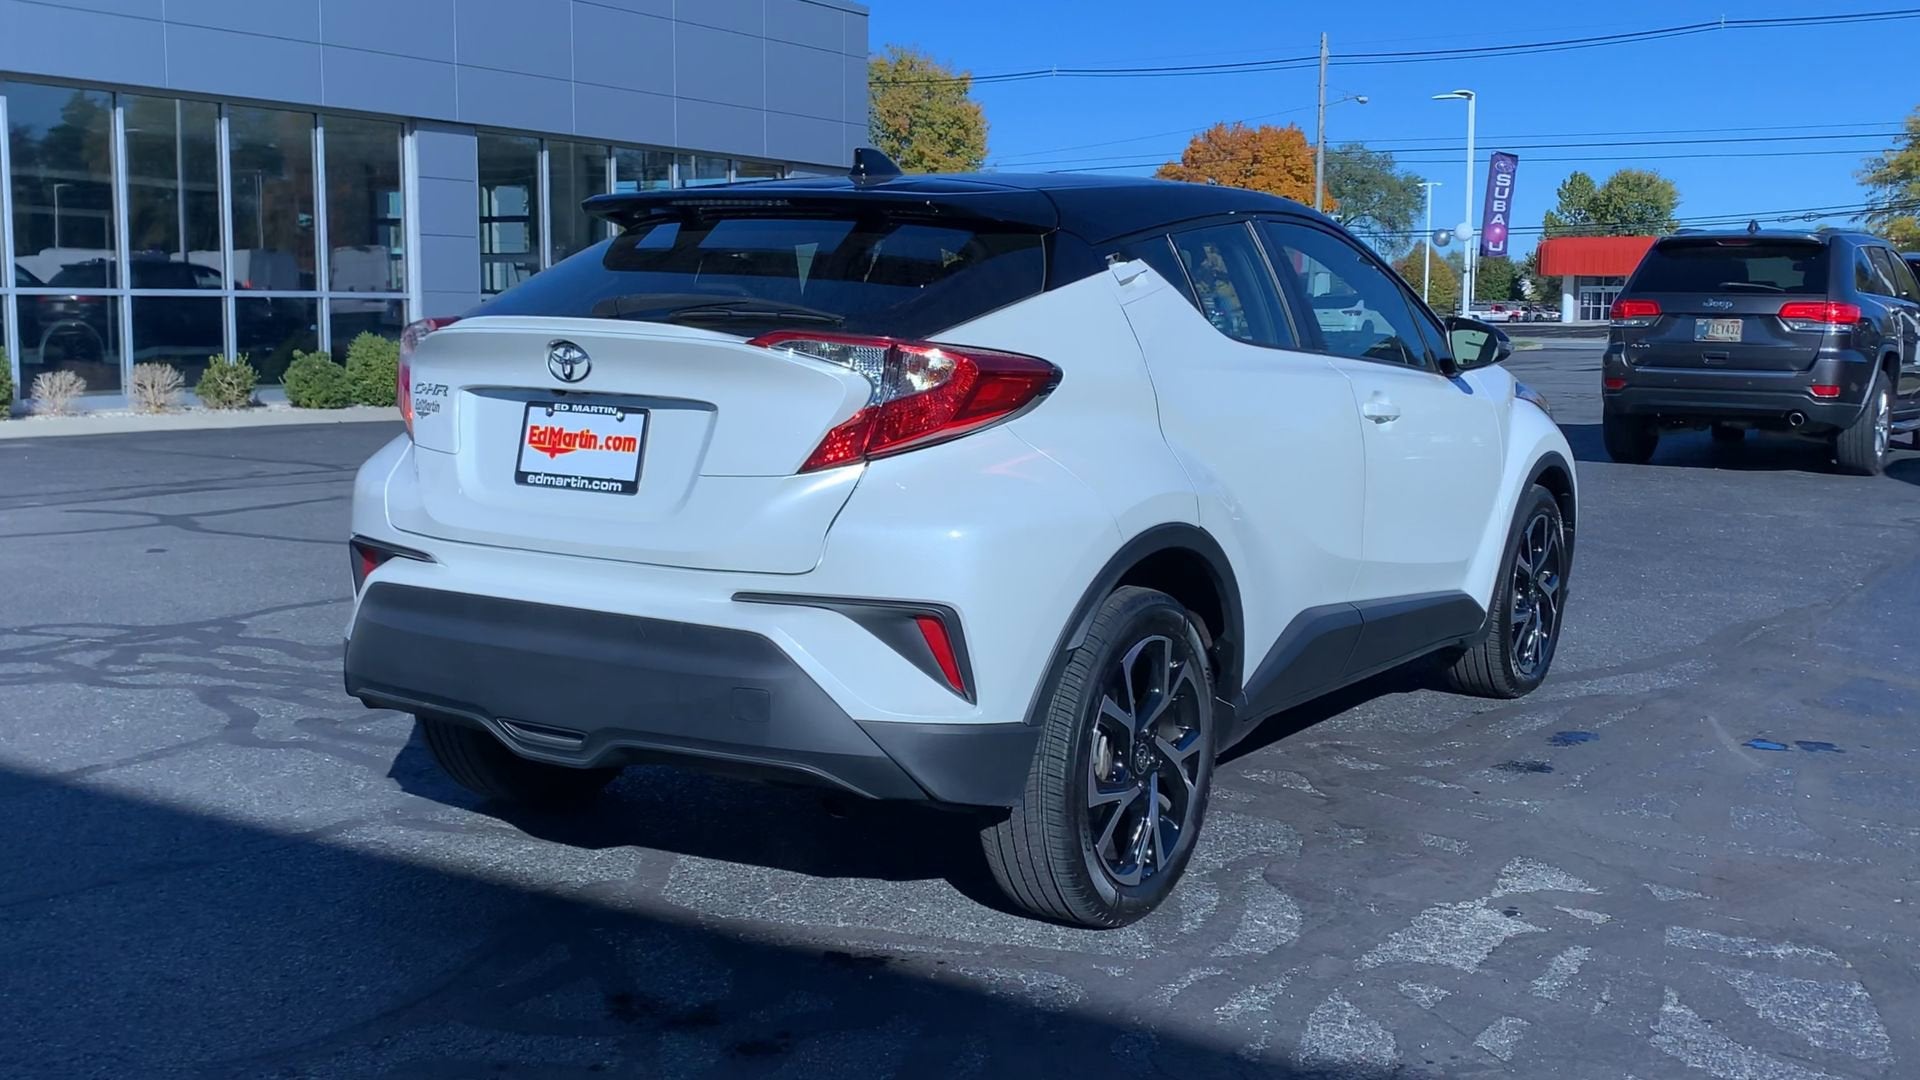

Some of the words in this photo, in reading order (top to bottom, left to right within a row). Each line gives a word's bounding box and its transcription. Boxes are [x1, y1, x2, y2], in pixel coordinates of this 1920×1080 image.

[1488, 173, 1511, 251] SUBAU
[1702, 298, 1733, 309] Jeep
[554, 403, 569, 411] ED
[572, 404, 617, 415] MARTIN
[528, 425, 637, 453] EdMartin.com
[527, 473, 622, 491] edmartin.com
